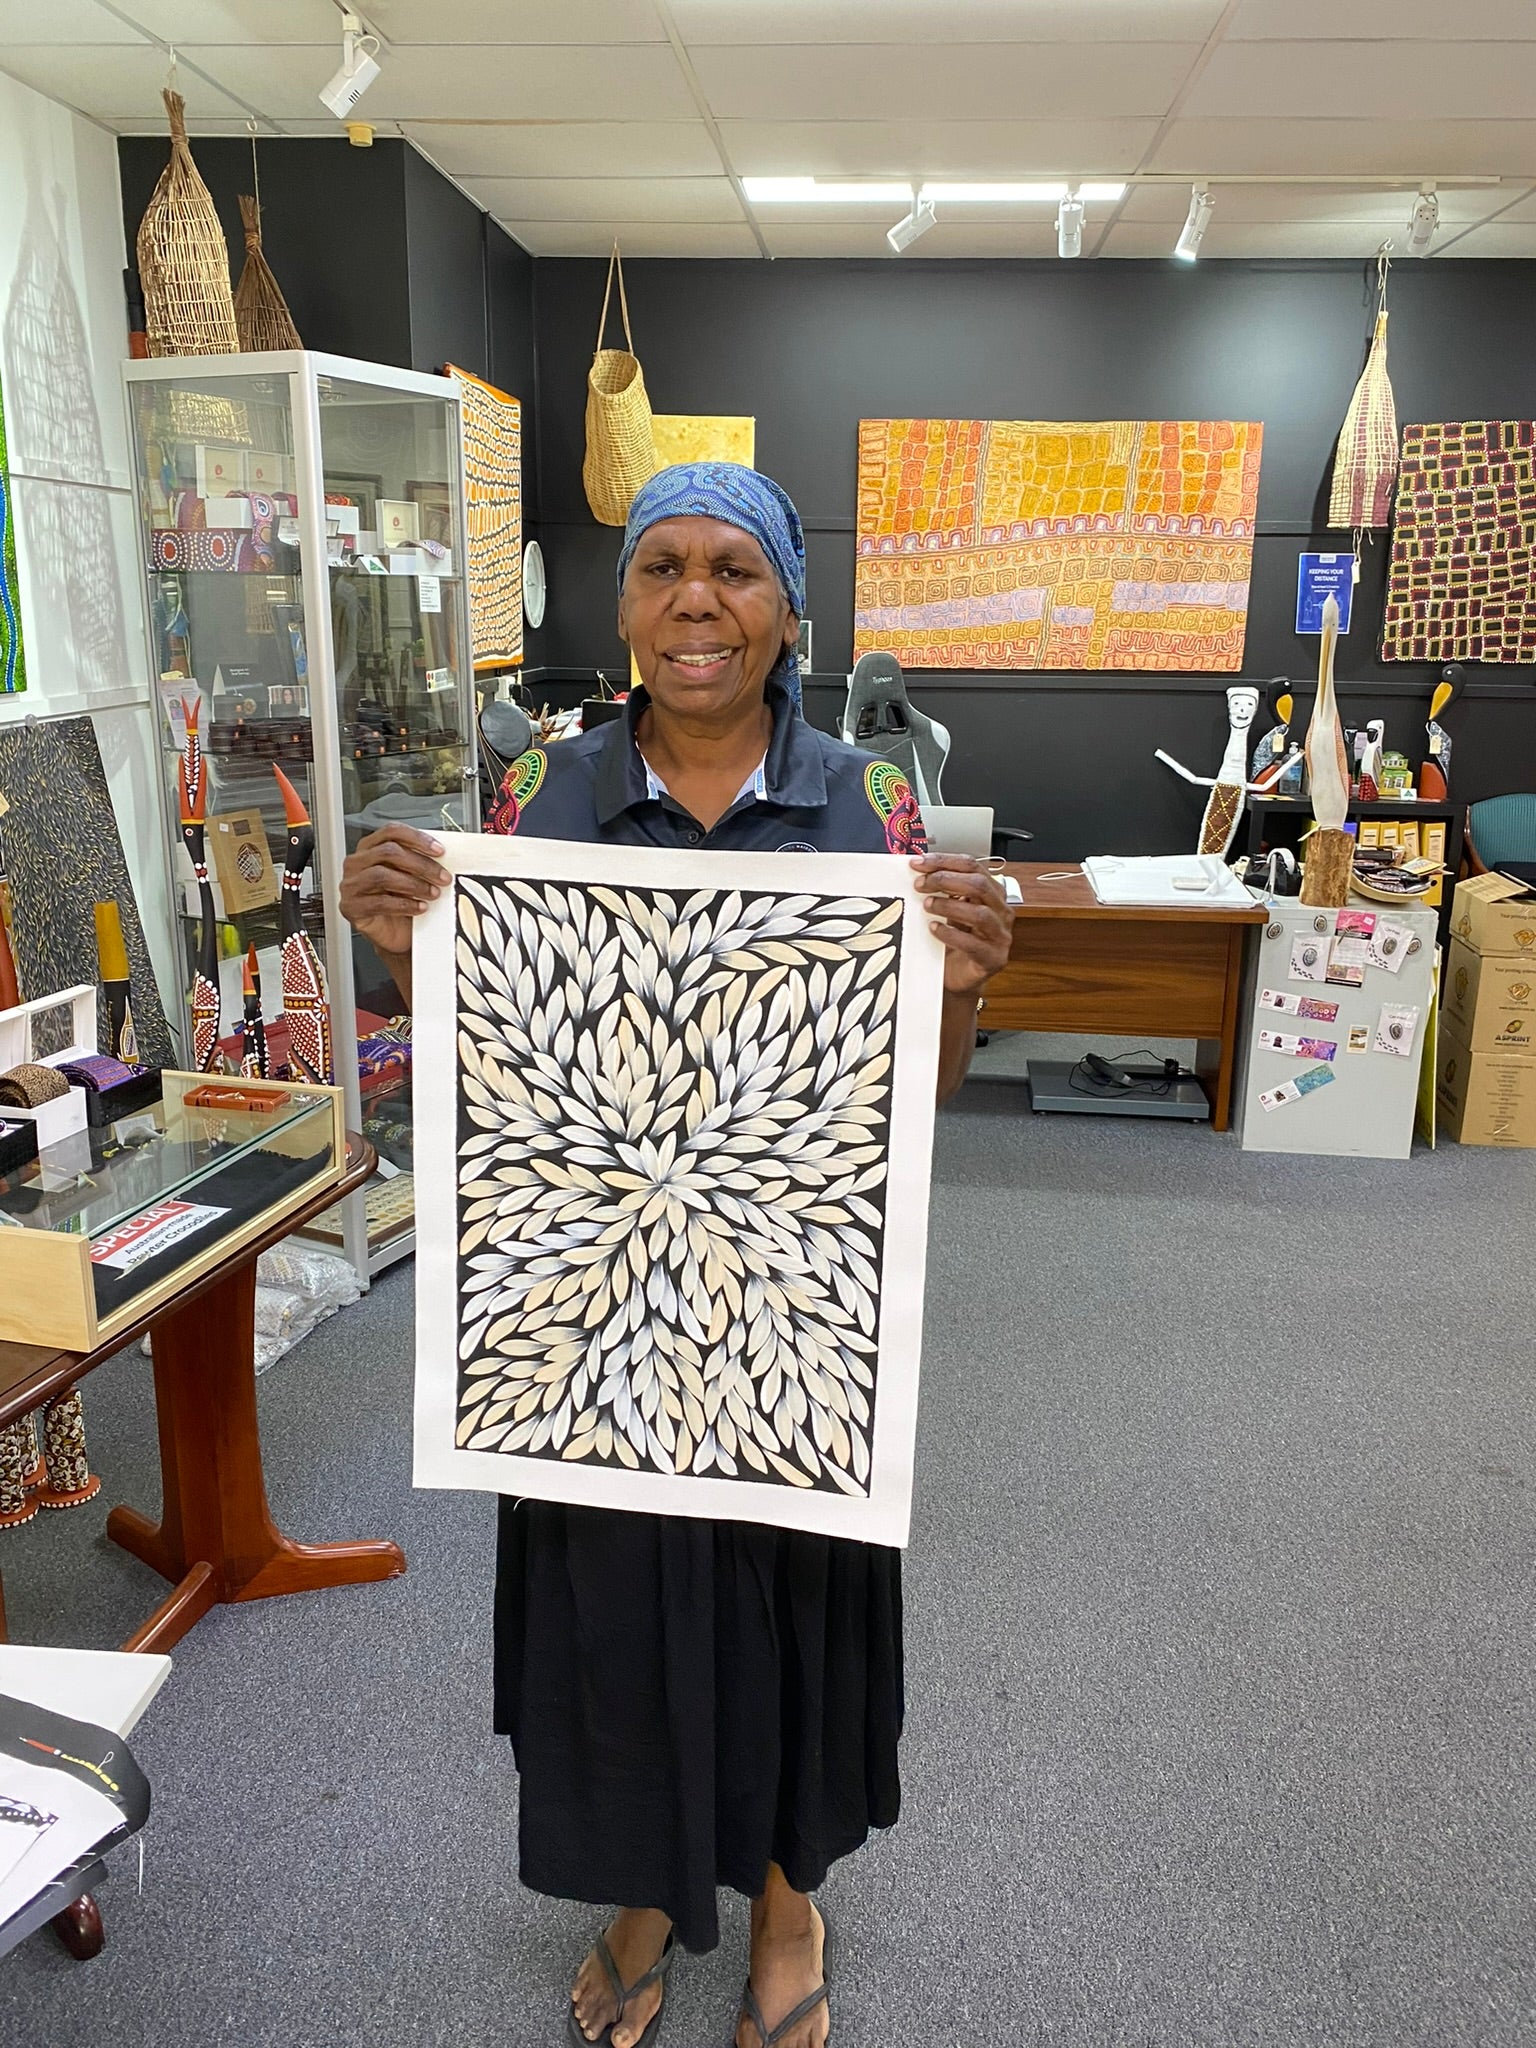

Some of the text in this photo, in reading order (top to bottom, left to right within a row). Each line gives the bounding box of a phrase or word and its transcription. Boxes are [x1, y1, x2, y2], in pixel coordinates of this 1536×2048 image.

[1494, 1034, 1531, 1043] ASPRINT
[89, 1204, 184, 1257] SPECIAL
[125, 1212, 195, 1256] Australian-made
[165, 1210, 218, 1240] Crocodiles
